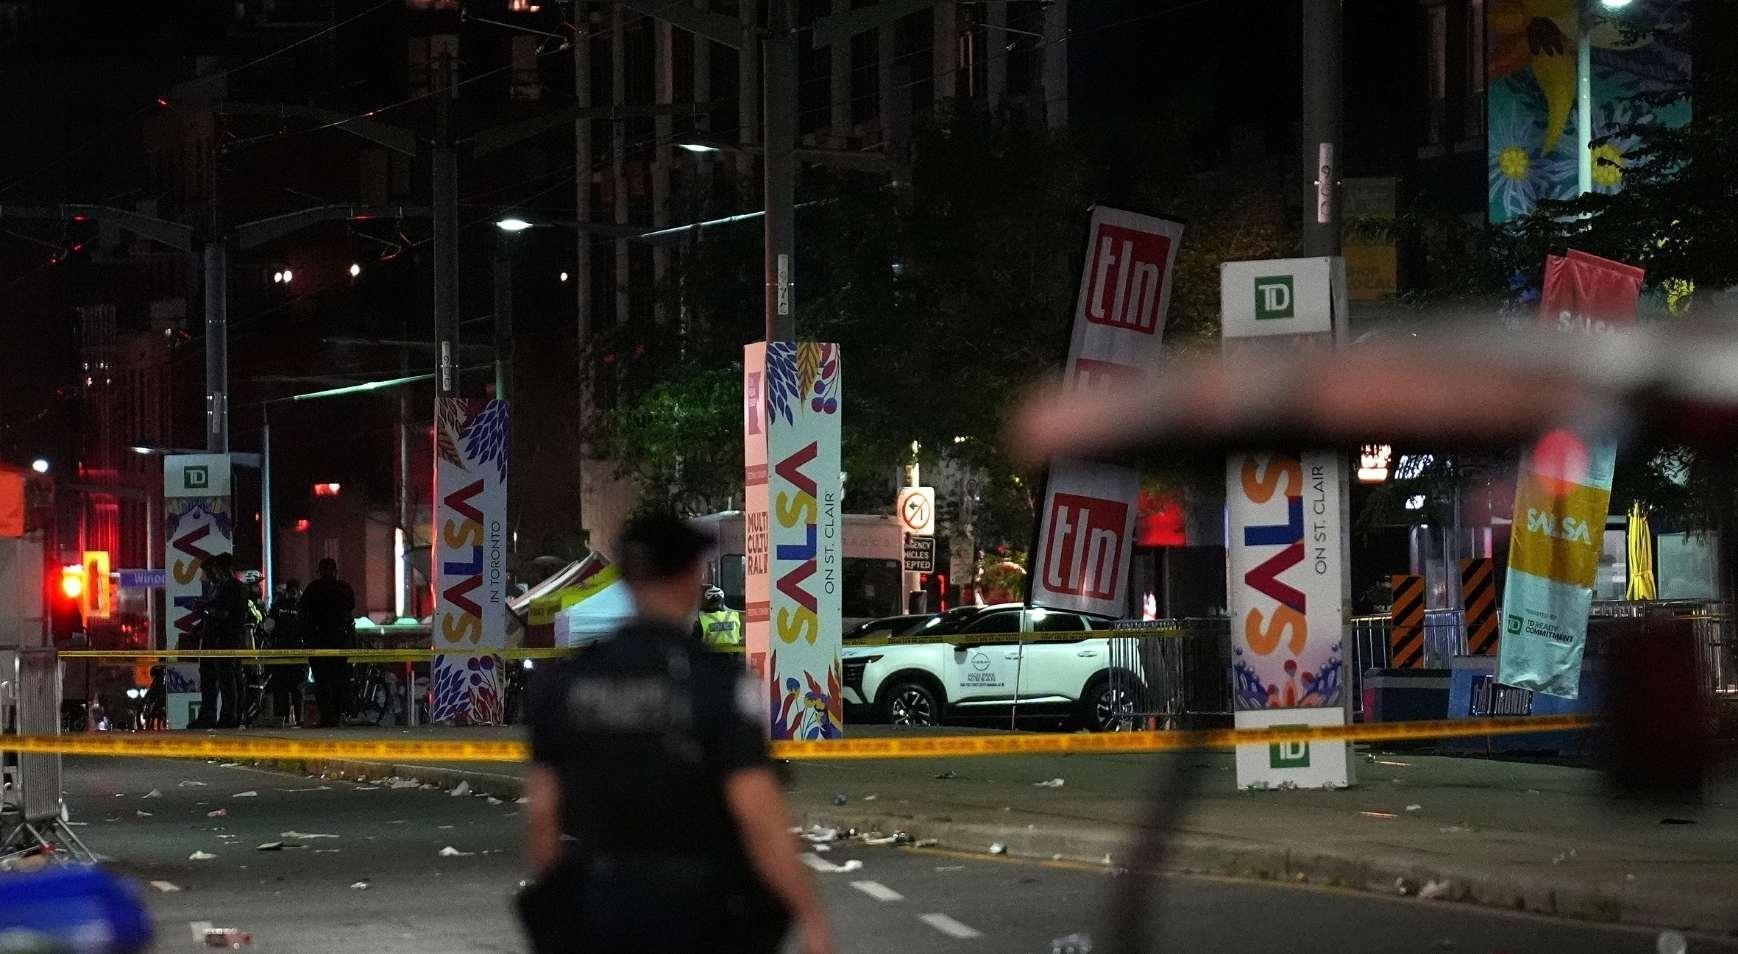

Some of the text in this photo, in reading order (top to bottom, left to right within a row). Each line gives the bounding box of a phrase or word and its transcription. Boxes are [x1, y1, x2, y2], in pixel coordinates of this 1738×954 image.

[1091, 236, 1160, 329] tln
[1257, 282, 1291, 312] TD
[186, 470, 206, 487] TD
[1311, 464, 1327, 516] CLAIR
[747, 511, 769, 533] MULTI
[824, 492, 835, 539] CLAIR
[442, 478, 485, 645] SALSA
[490, 520, 501, 603] IN TORONTO
[747, 533, 769, 553] CULTU
[774, 440, 820, 647] SALSA
[1048, 505, 1118, 595] tln
[1240, 453, 1309, 657] SALS
[1313, 547, 1328, 576] ON
[134, 571, 166, 586] Wino
[824, 569, 835, 595] ON
[906, 560, 932, 570] EPTED
